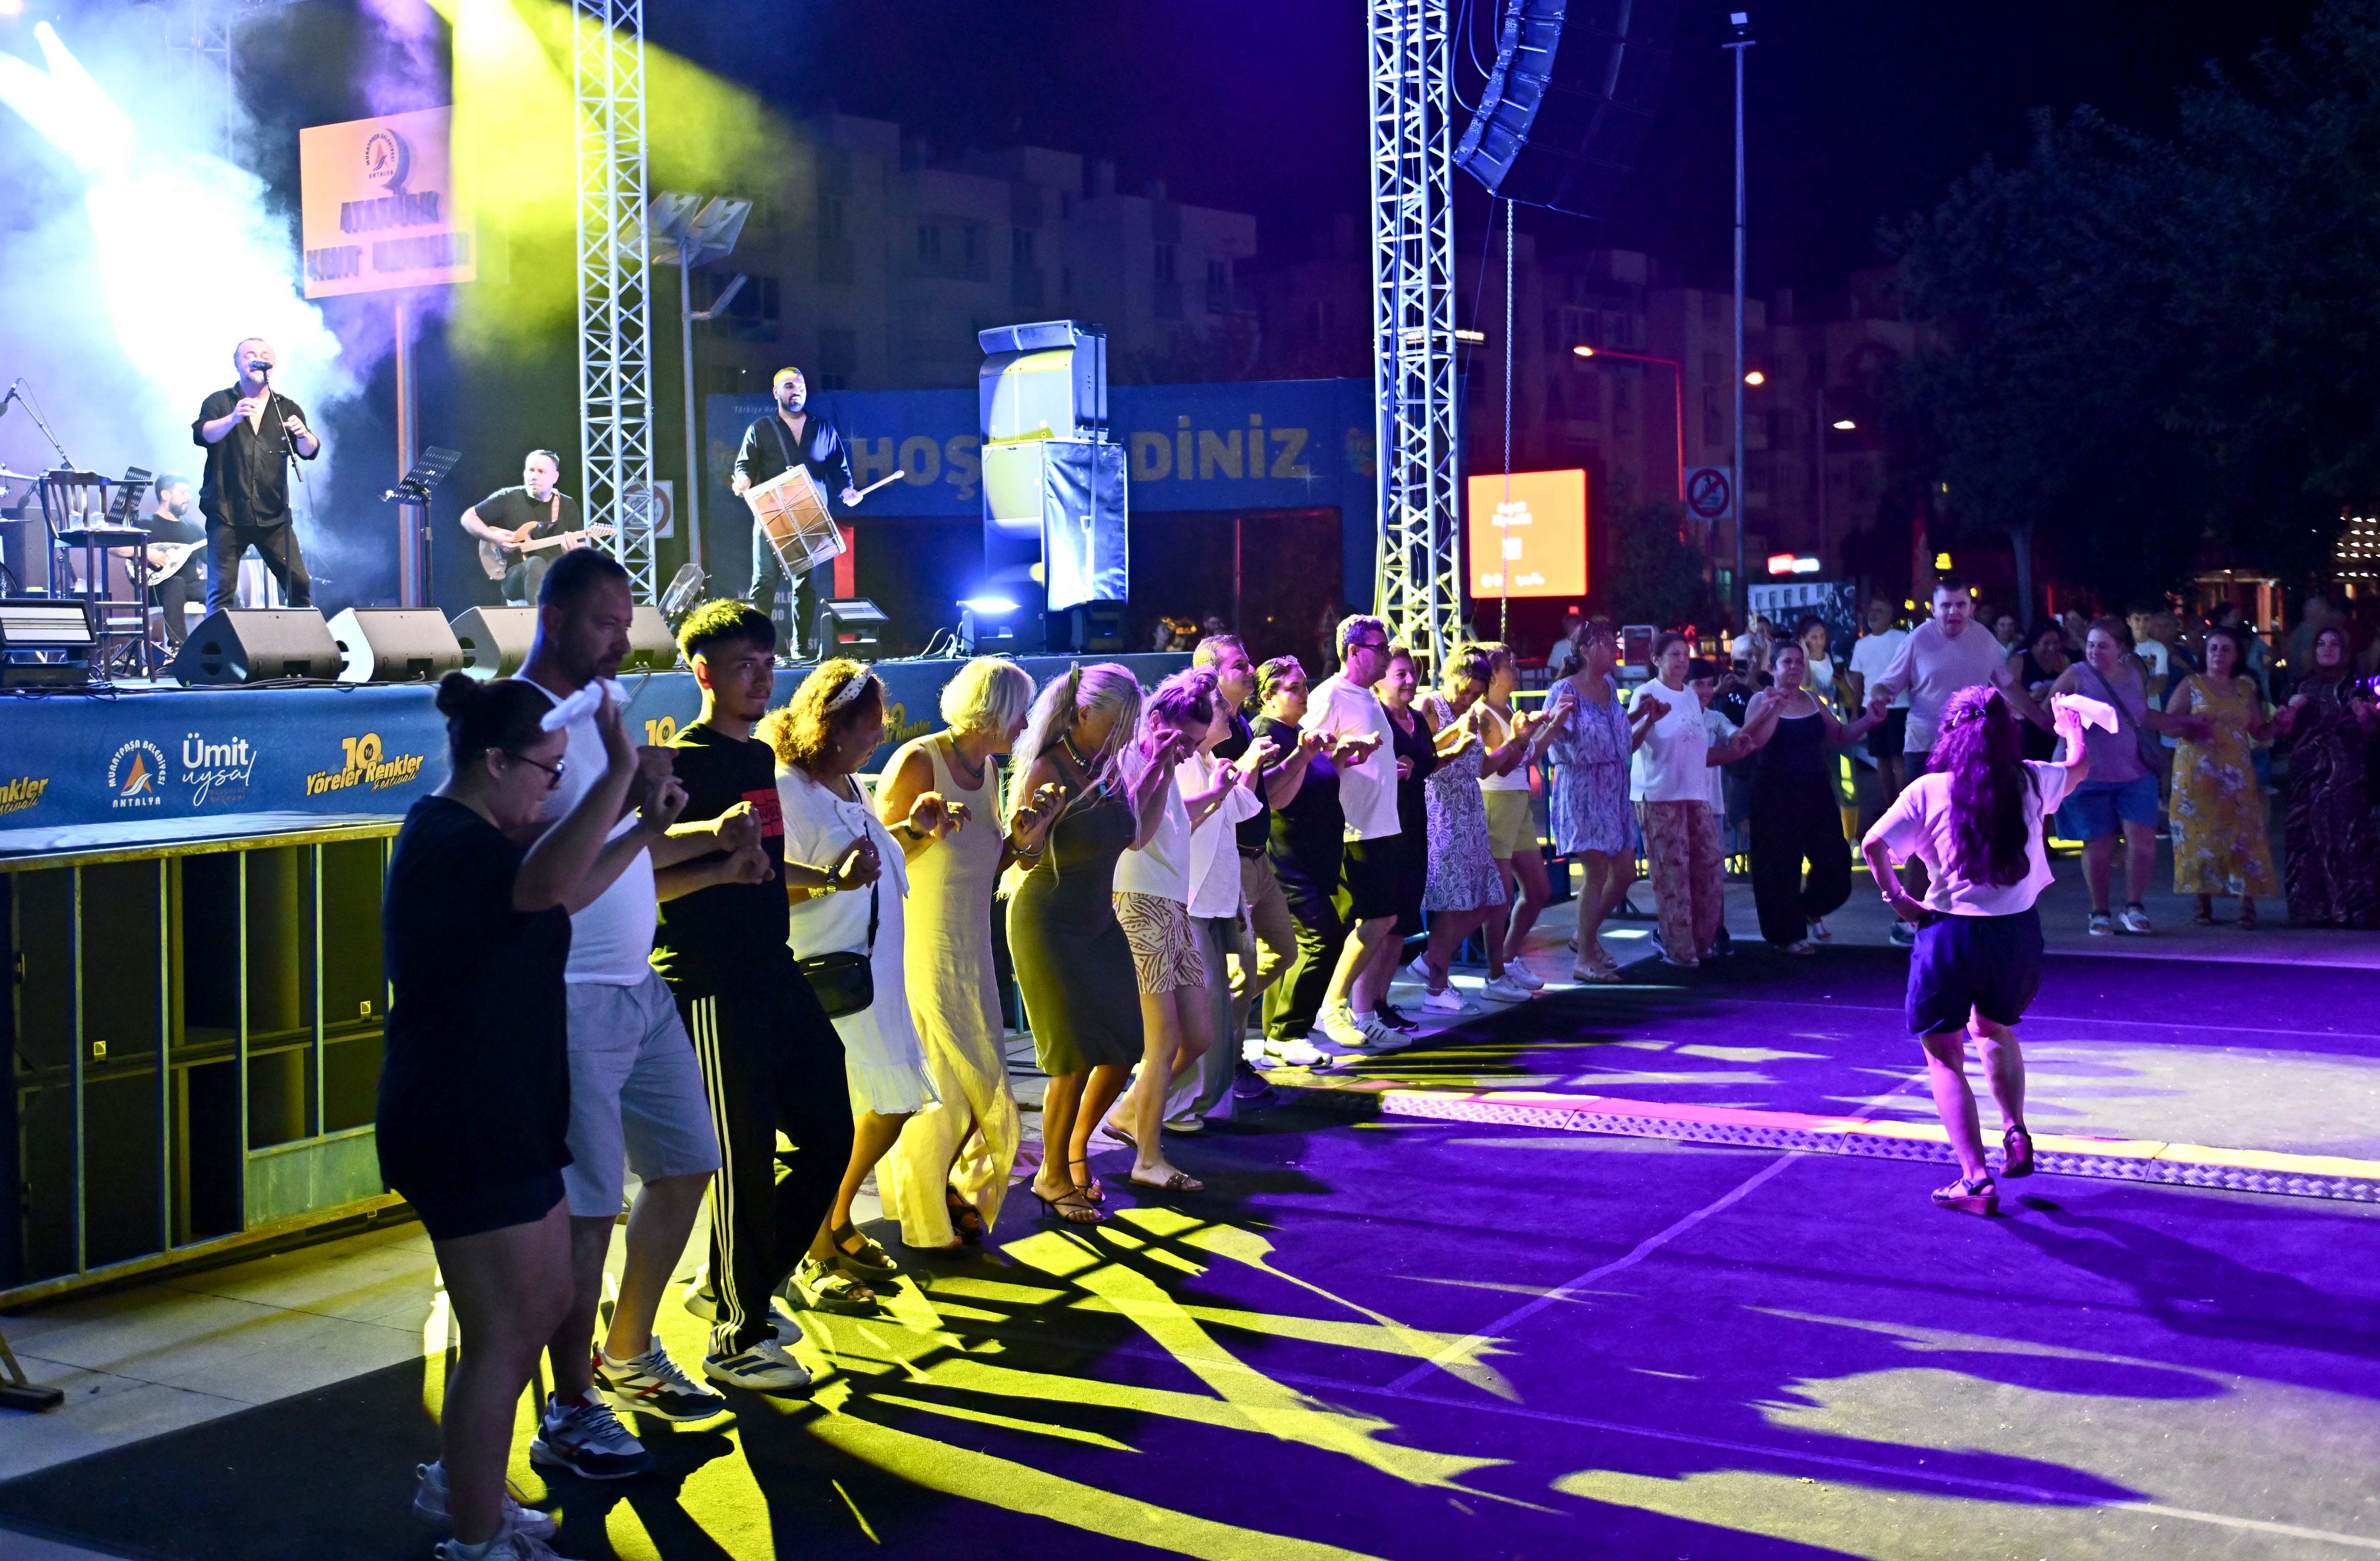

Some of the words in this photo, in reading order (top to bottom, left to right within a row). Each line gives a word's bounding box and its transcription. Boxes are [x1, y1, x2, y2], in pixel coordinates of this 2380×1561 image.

[852, 435, 981, 501] HOŞ
[1130, 413, 1309, 482] DİNİZ
[108, 739, 140, 787] MURATPAŞA
[183, 733, 249, 769] Ümit
[0, 776, 49, 803] nkler
[306, 767, 363, 795] Yöreler
[365, 754, 424, 783] Renkler
[113, 796, 161, 808] ANTALYA
